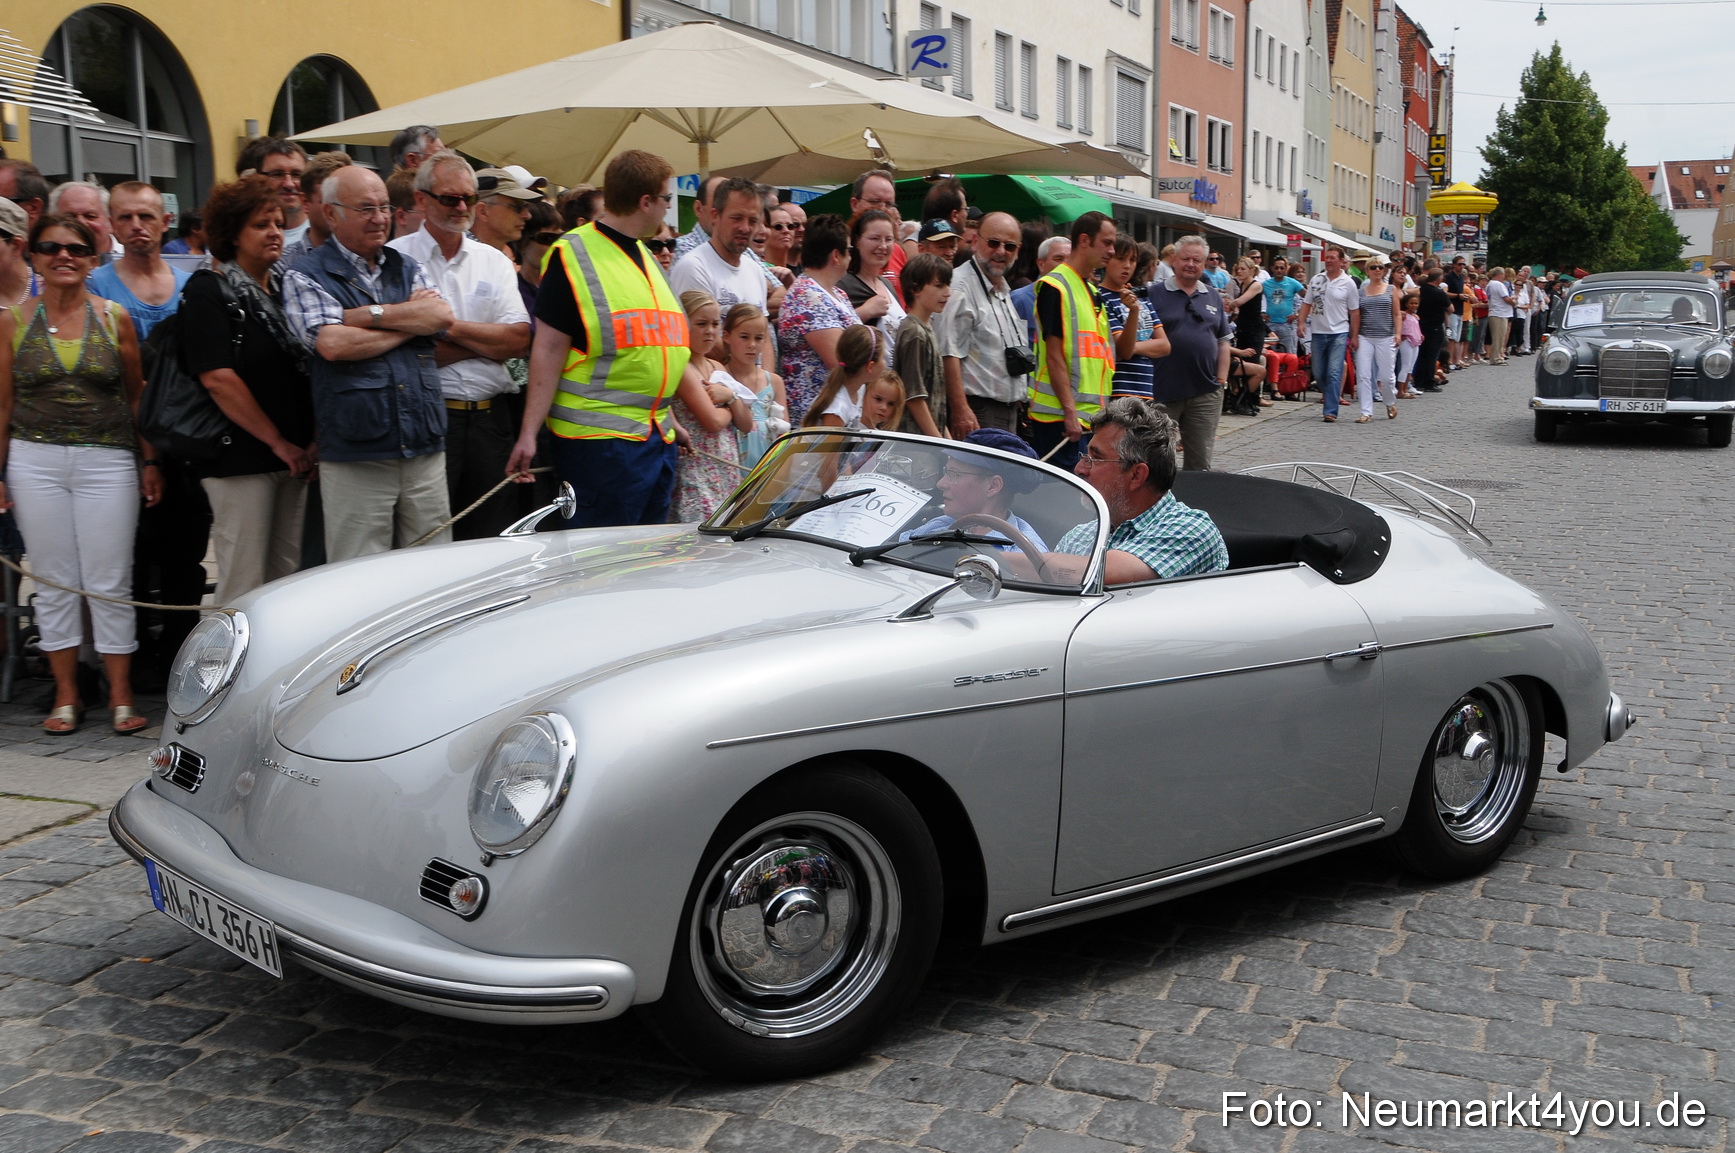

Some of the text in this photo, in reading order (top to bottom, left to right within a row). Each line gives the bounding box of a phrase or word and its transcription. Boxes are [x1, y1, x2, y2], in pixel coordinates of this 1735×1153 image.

[1430, 135, 1446, 192] HOT
[1606, 401, 1664, 412] RH SF 61H
[851, 493, 903, 517] 266
[157, 870, 184, 919] AN
[188, 889, 218, 939] CI
